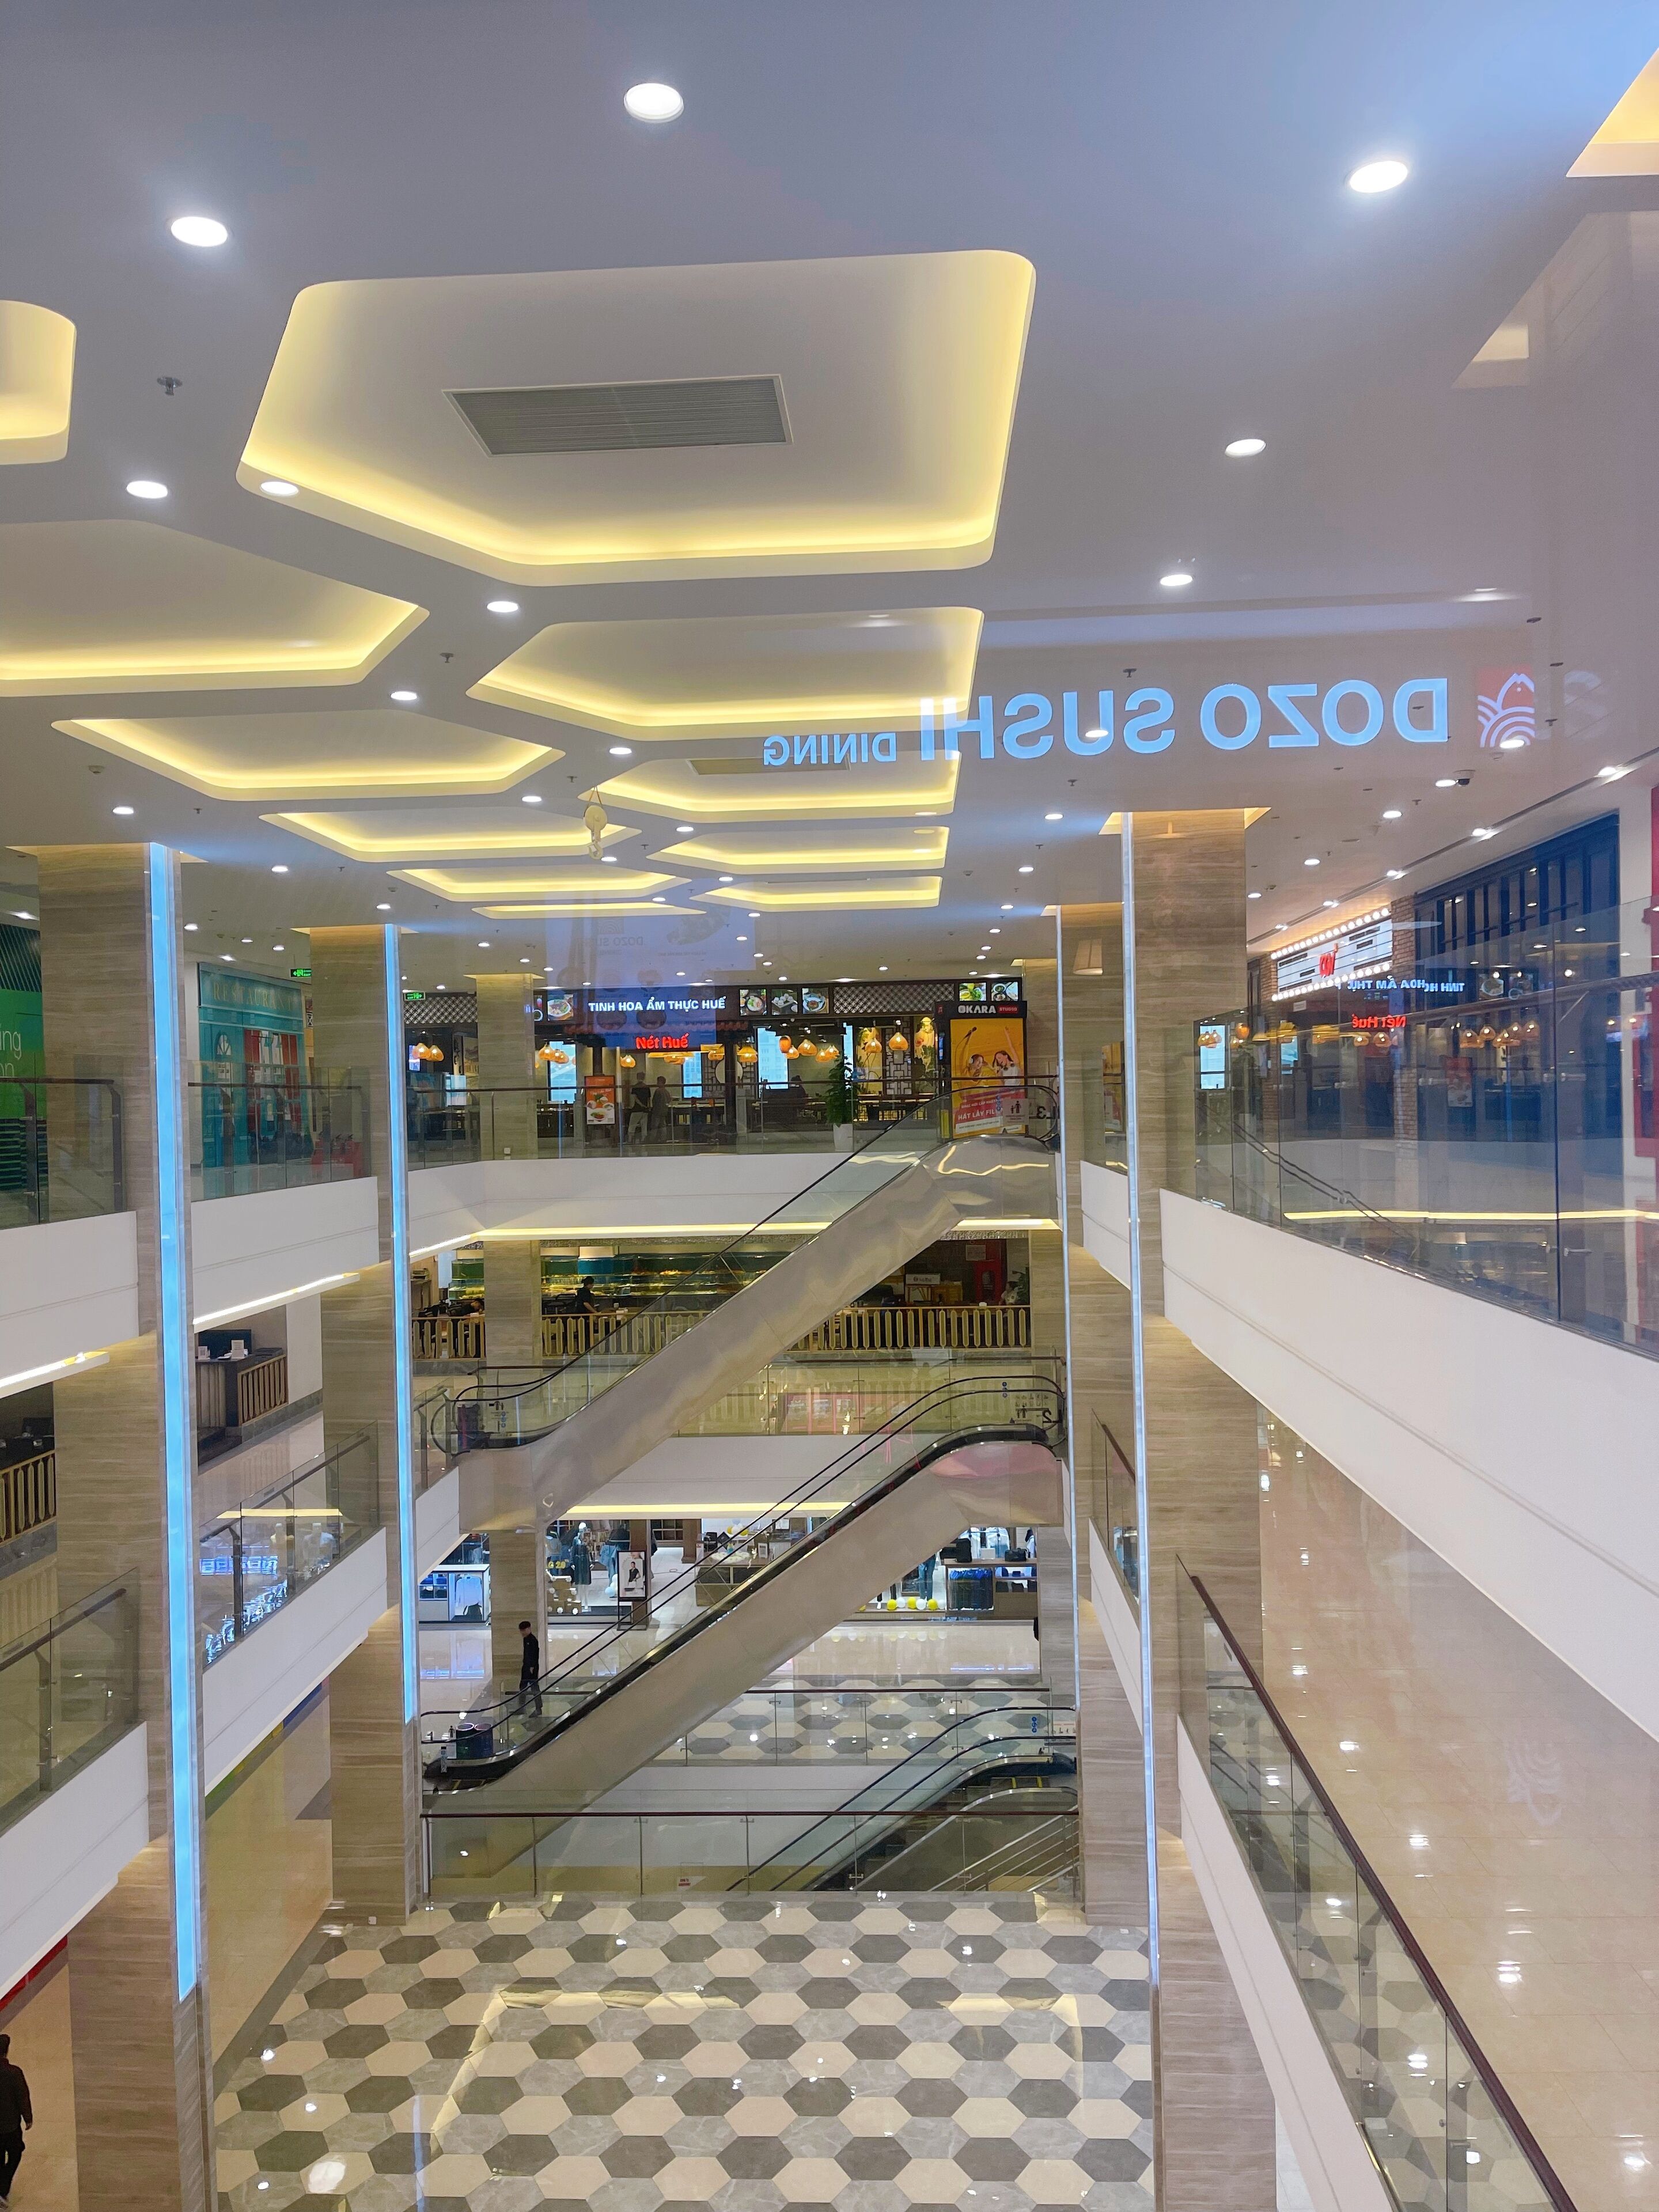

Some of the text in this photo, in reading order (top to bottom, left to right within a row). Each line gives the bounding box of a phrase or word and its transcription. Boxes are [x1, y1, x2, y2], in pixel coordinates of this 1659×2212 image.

[588, 995, 726, 1012] TINH HOA ẨM THỰC HUẾ
[958, 1005, 997, 1014] OKARA
[0, 1031, 21, 1060] ng
[636, 1032, 689, 1049] Nét Huế
[958, 1111, 972, 1120] HÁT
